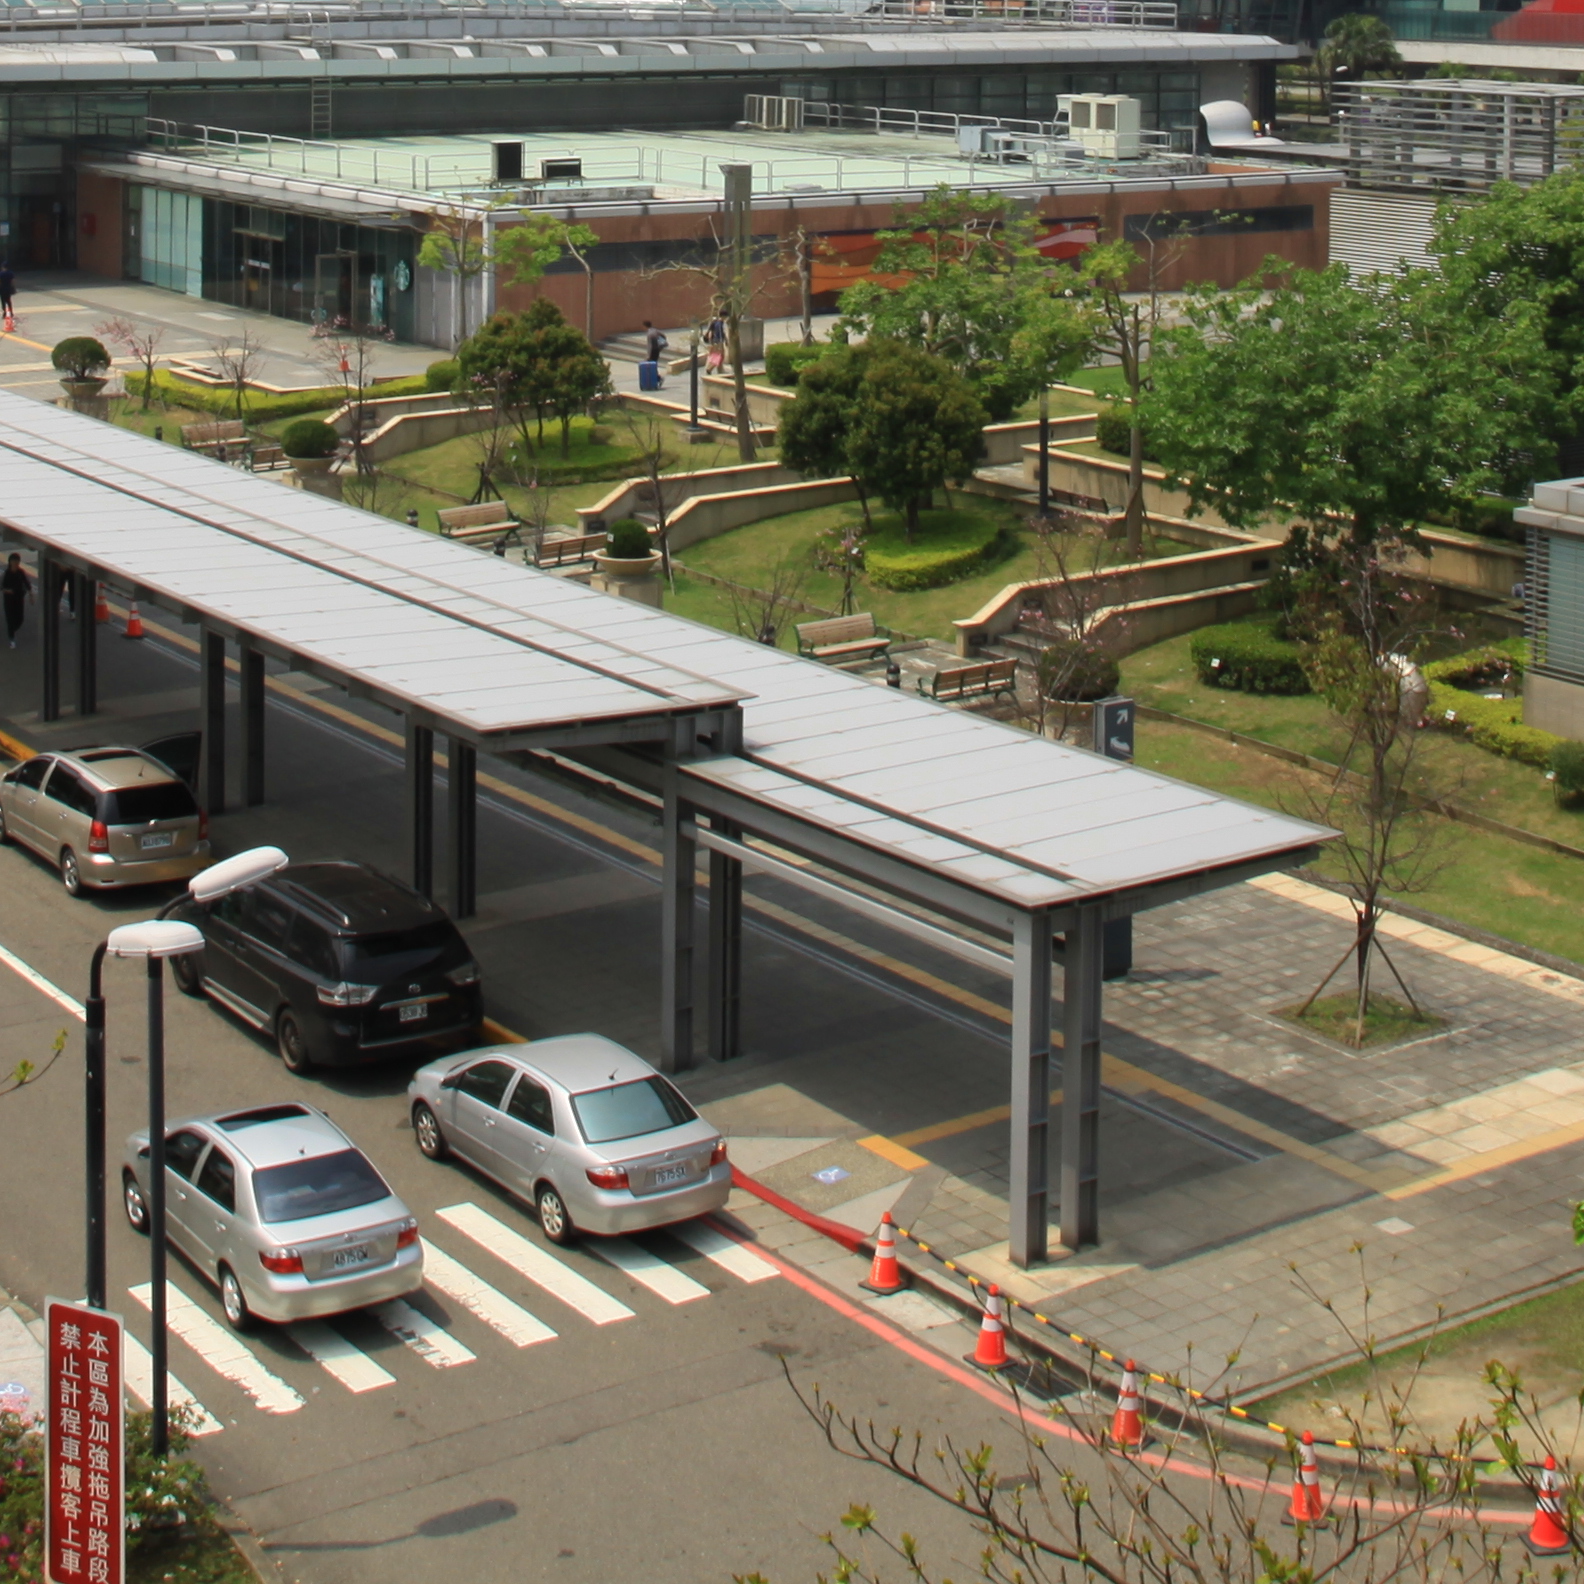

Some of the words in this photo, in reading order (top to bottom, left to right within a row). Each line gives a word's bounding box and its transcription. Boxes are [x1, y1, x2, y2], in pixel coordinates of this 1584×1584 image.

[59, 1321, 82, 1576] 禁止計程車攬客上車
[87, 1330, 110, 1584] 本區為加強拖吊路段
